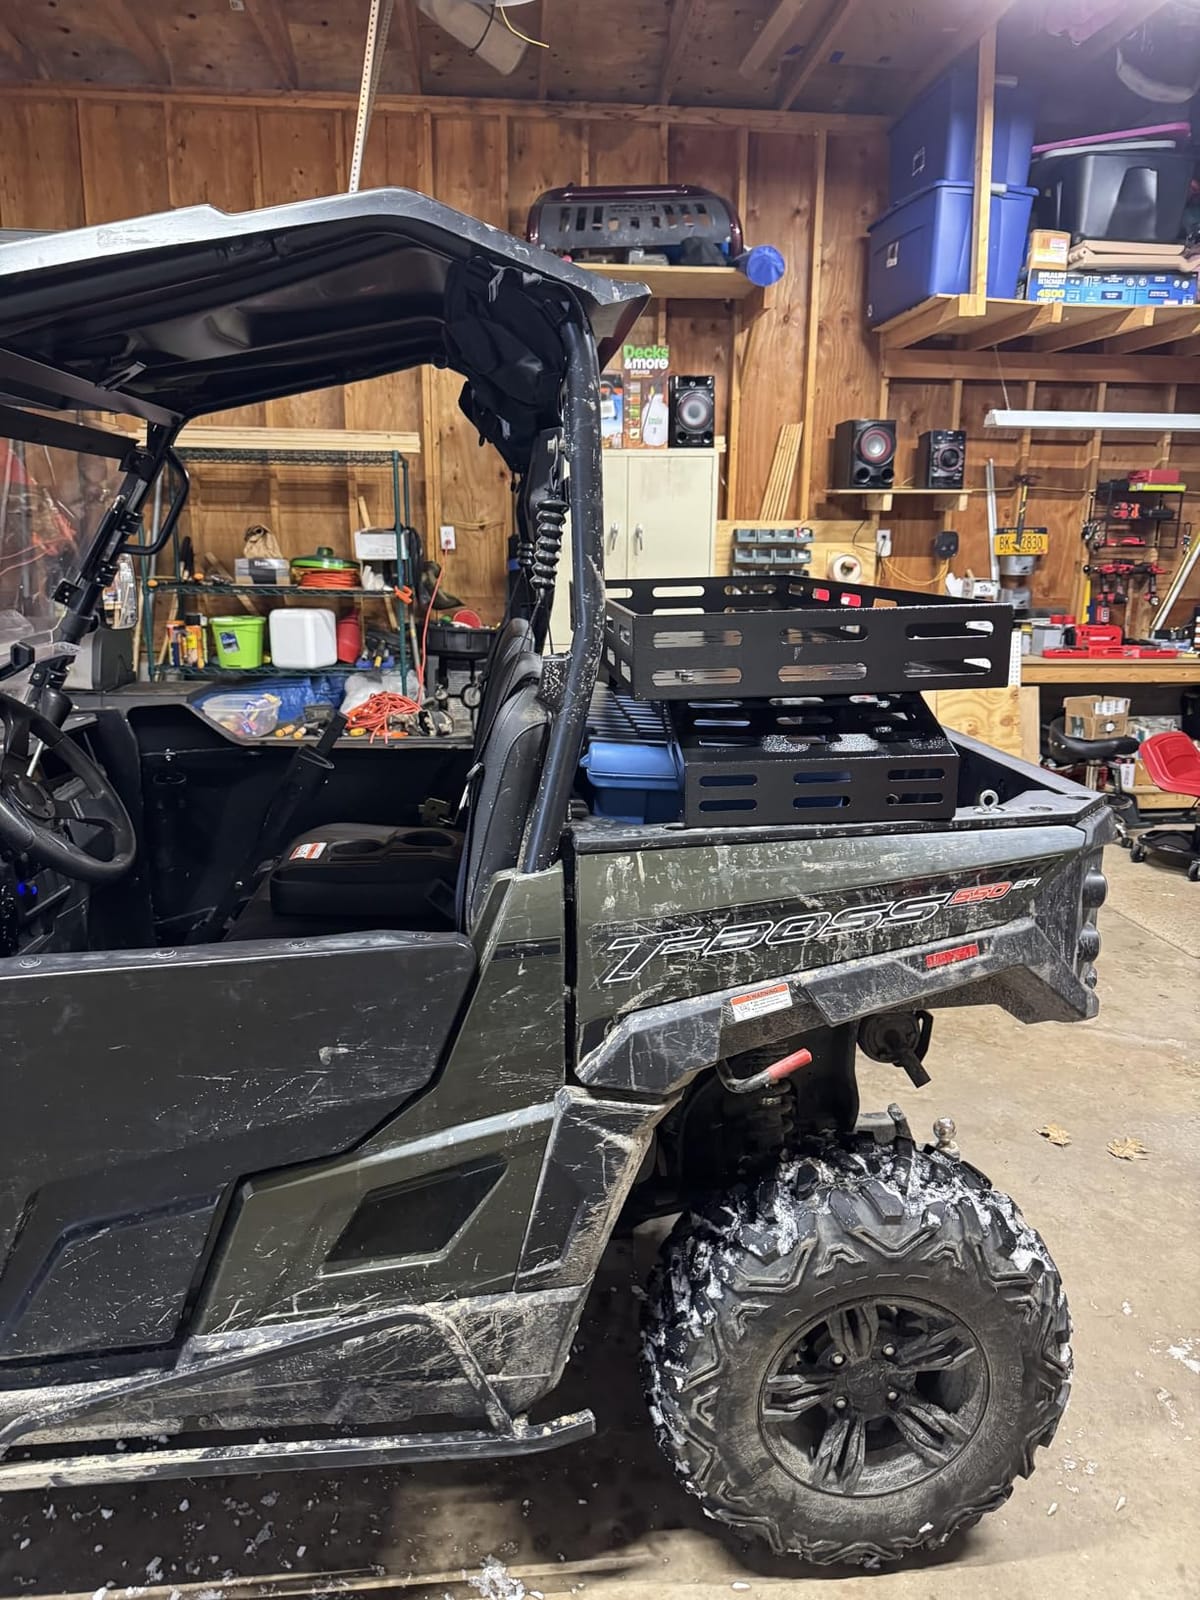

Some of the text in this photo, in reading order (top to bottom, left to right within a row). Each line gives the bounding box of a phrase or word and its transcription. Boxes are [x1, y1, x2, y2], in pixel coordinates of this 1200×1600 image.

[1037, 289, 1065, 298] 4500
[623, 345, 669, 358] Decks
[624, 358, 669, 370] &more
[602, 876, 1042, 984] T-BOSS 550 EFI
